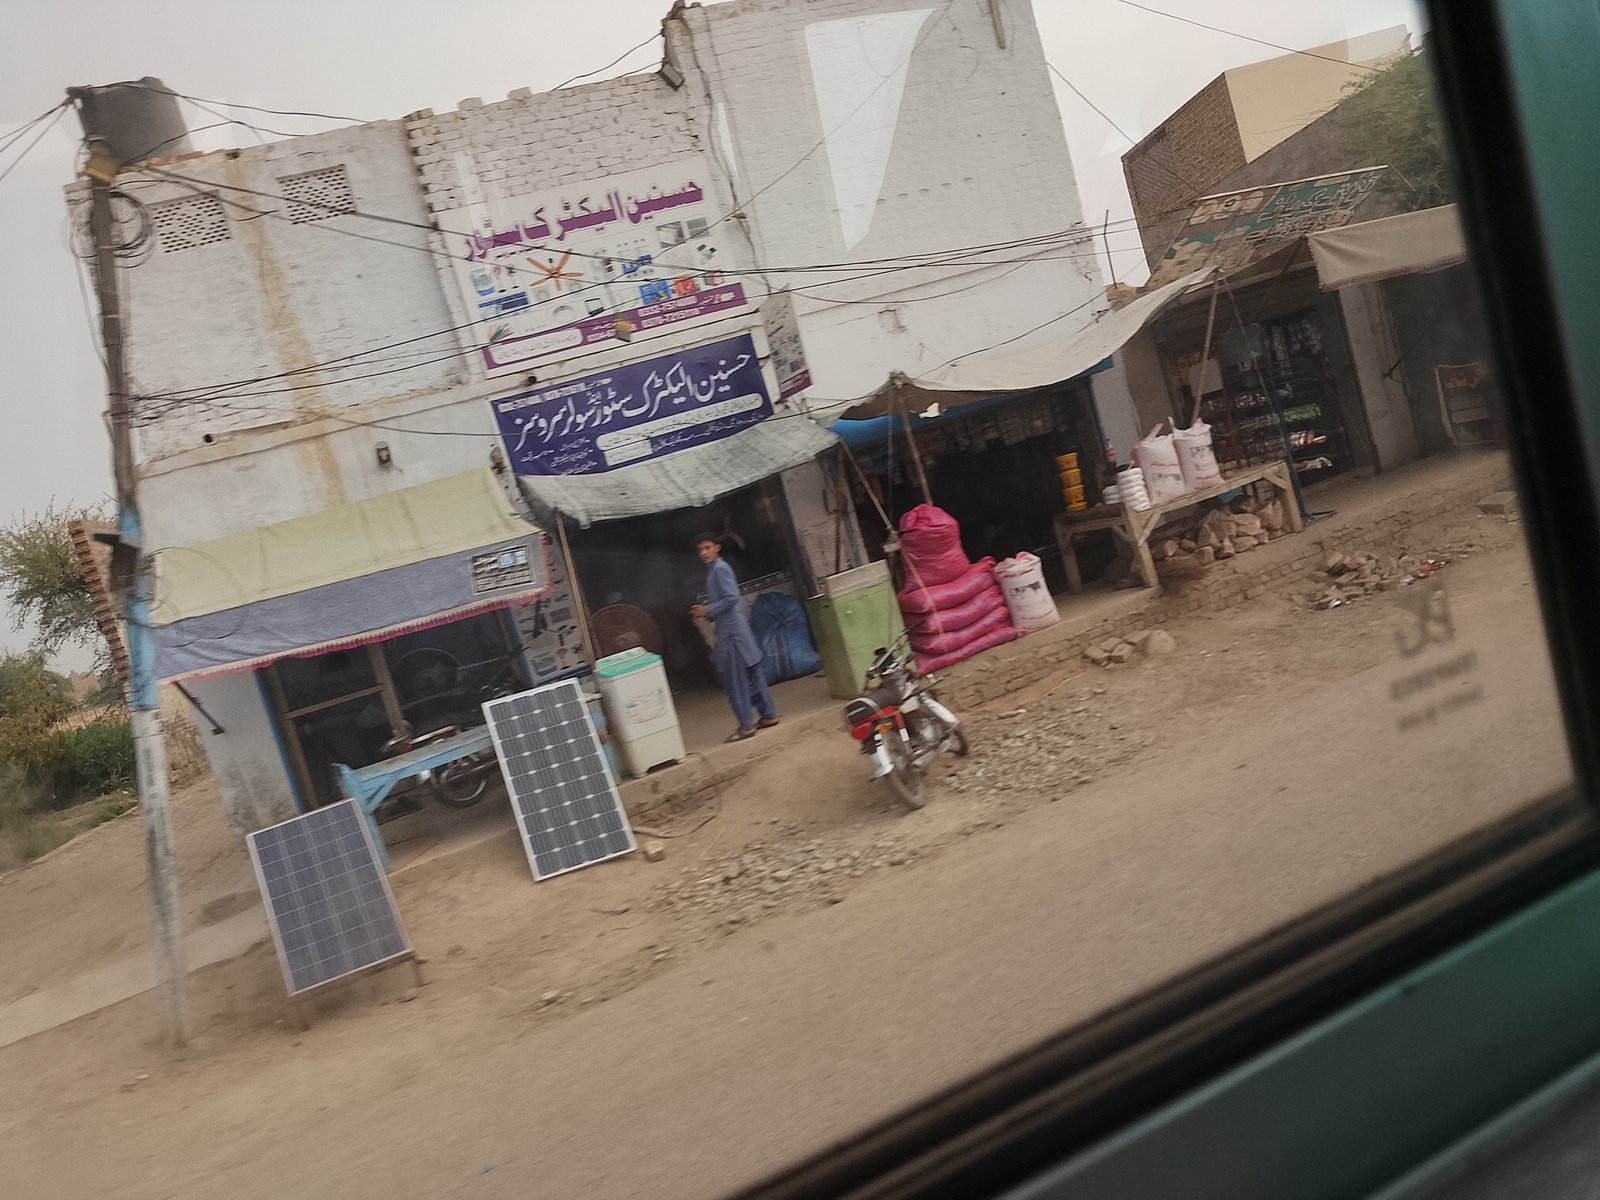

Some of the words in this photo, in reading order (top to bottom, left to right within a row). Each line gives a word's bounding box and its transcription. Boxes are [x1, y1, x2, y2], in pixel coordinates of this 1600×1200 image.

[621, 361, 696, 418] الیکٹرک
[695, 354, 751, 402] حسنین
[558, 396, 598, 438] سولر
